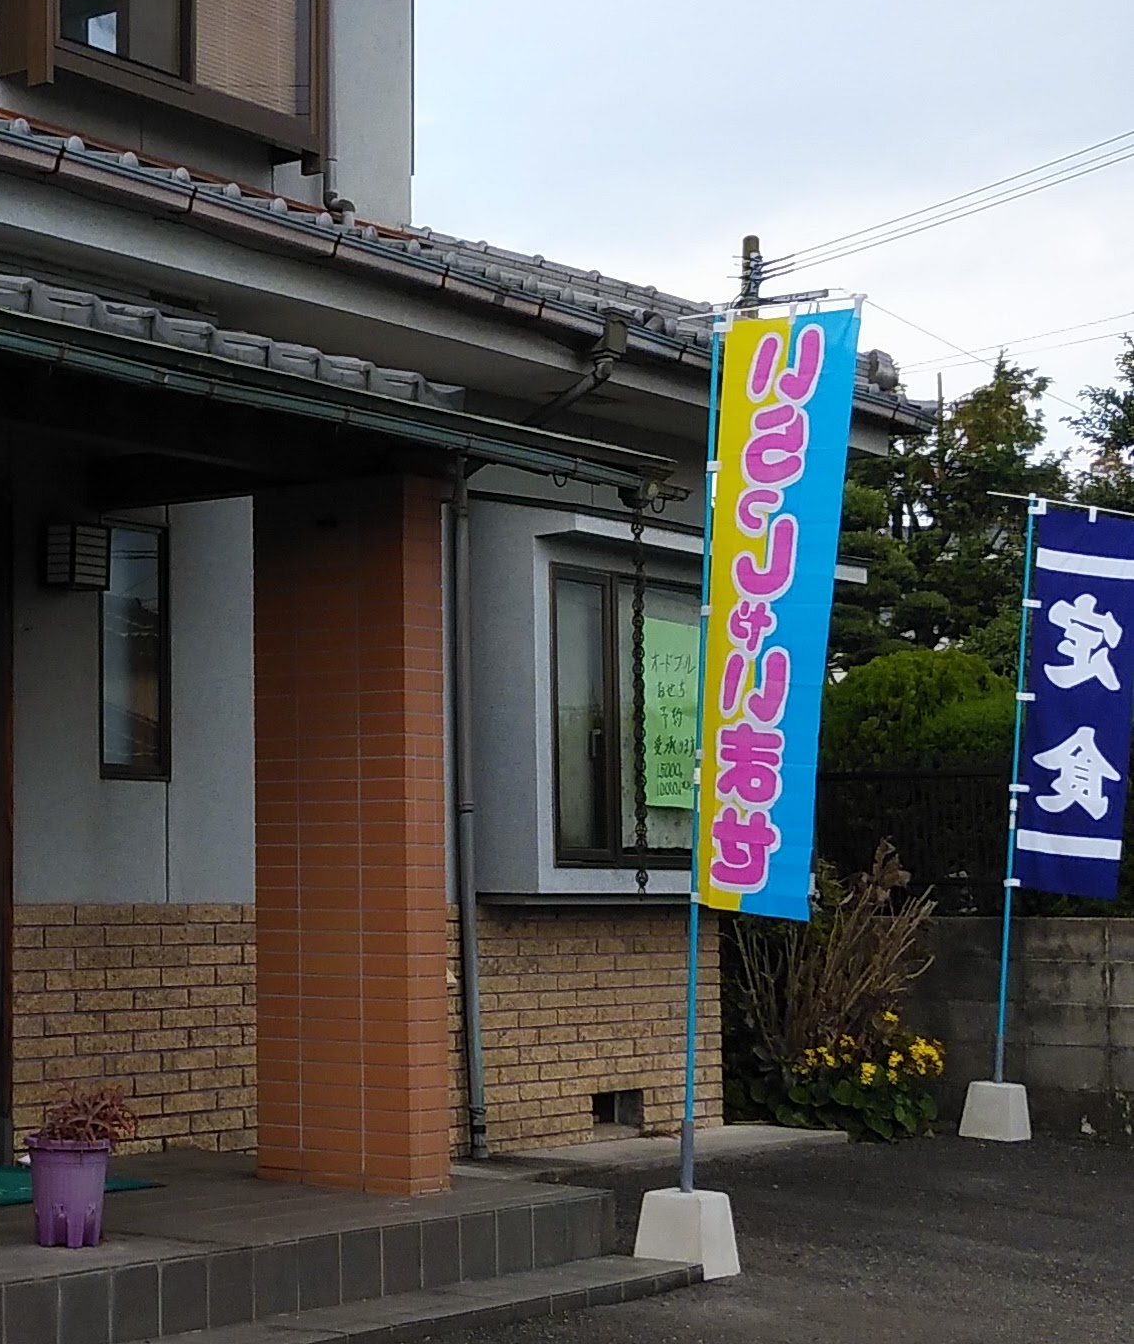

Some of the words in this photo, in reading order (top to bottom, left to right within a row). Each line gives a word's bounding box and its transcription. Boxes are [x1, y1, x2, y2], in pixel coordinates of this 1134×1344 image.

[657, 679, 685, 698] おせち
[659, 705, 683, 729] 予約
